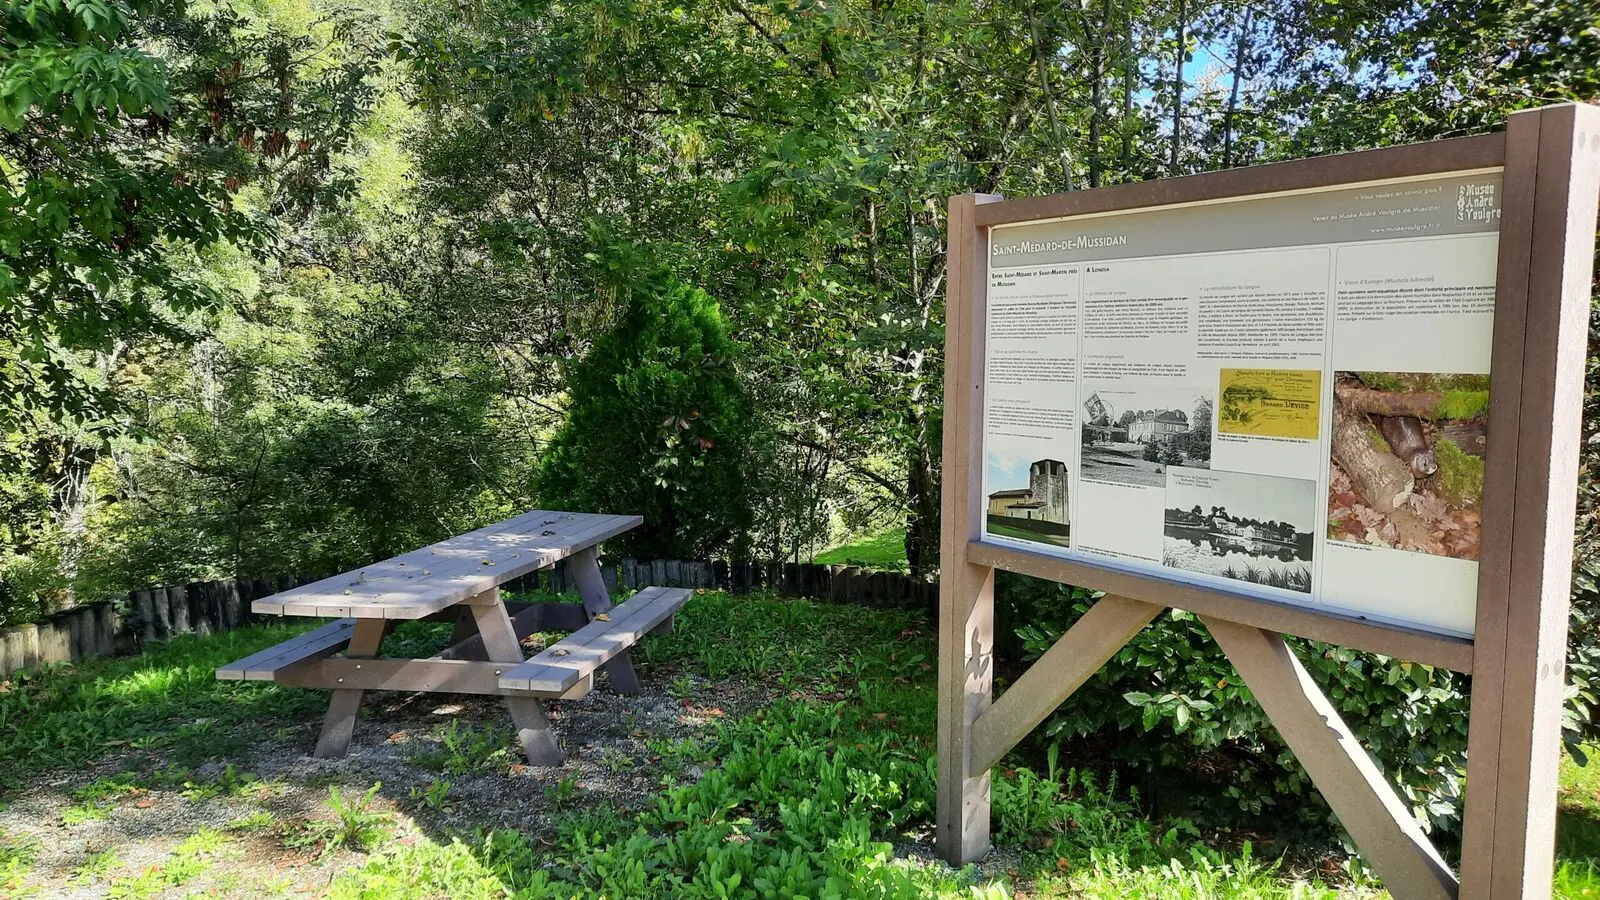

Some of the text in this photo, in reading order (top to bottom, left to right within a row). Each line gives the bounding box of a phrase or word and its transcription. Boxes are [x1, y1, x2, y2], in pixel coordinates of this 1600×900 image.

[1466, 184, 1495, 196] Musée
[1465, 196, 1494, 208] André
[1339, 212, 1357, 220] Musée
[1379, 208, 1401, 216] Voulgre
[1466, 208, 1501, 223] Voulgre
[993, 235, 1127, 256] SAINT-MÉDARD-DE-MUSSIDAN
